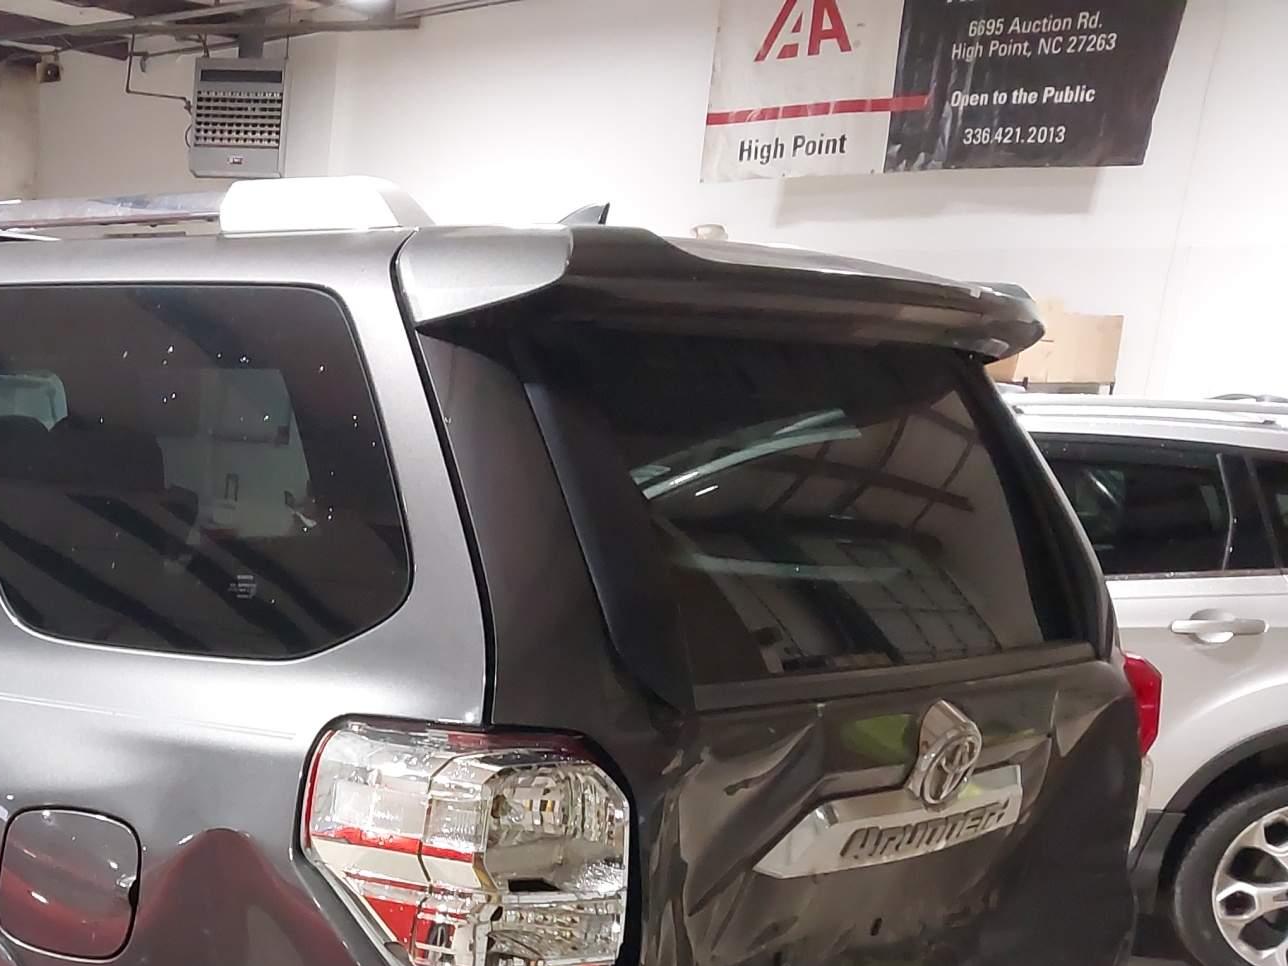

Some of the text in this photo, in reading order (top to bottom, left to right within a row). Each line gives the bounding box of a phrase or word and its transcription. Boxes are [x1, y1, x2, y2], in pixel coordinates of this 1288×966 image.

[968, 11, 1103, 38] 6695 Auction Rd.
[951, 33, 1118, 63] High Point, NC 27263
[951, 84, 1096, 112] Open to the Public
[738, 132, 848, 165] High Point
[962, 125, 1066, 146] 336.421.2013
